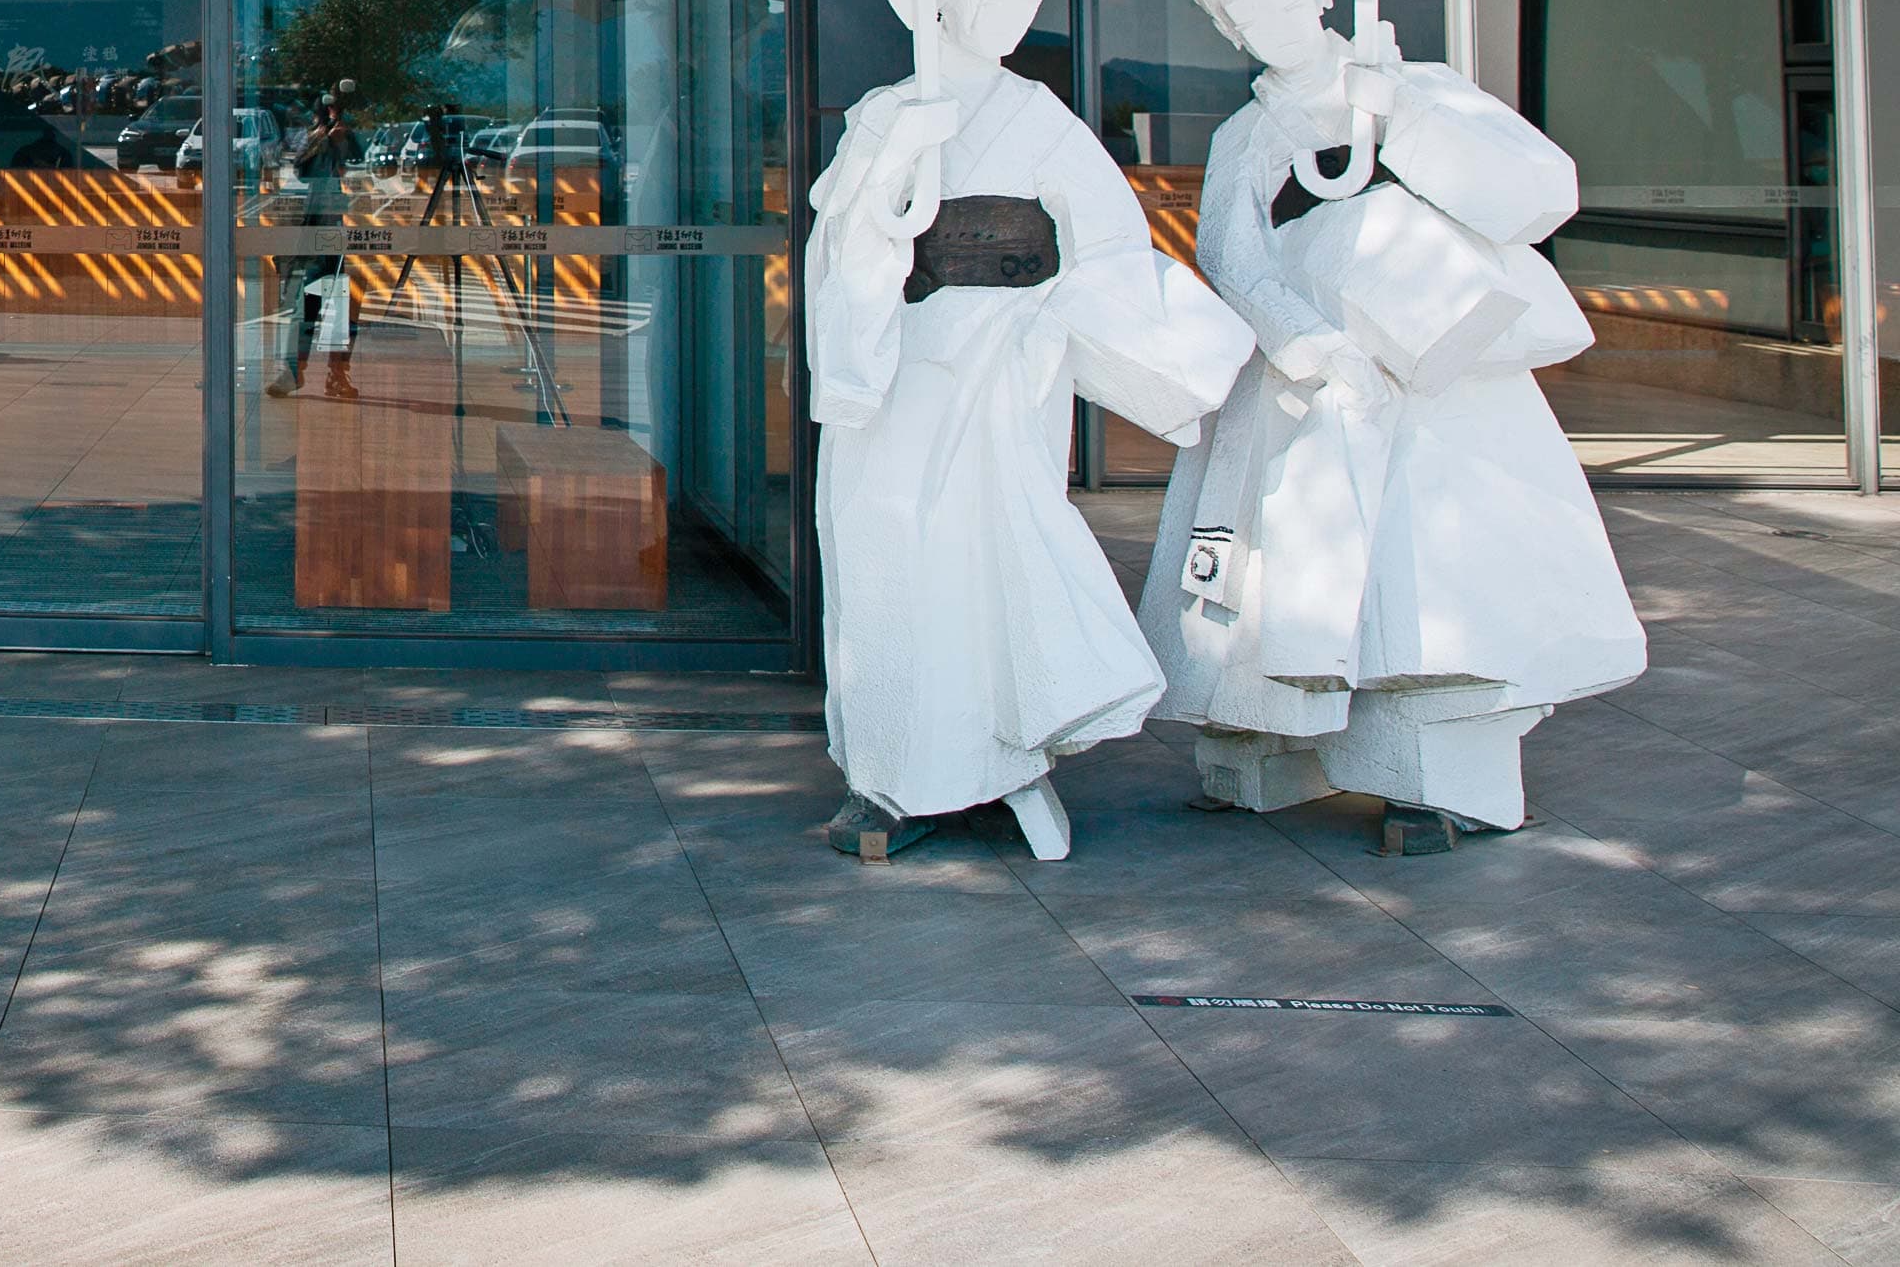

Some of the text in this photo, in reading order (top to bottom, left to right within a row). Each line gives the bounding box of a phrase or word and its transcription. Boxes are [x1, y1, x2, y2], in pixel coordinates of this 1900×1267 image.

[1290, 999, 1354, 1011] Please
[1356, 1001, 1385, 1011] Do
[1388, 1002, 1423, 1013] Not
[1423, 1004, 1485, 1014] Touch
